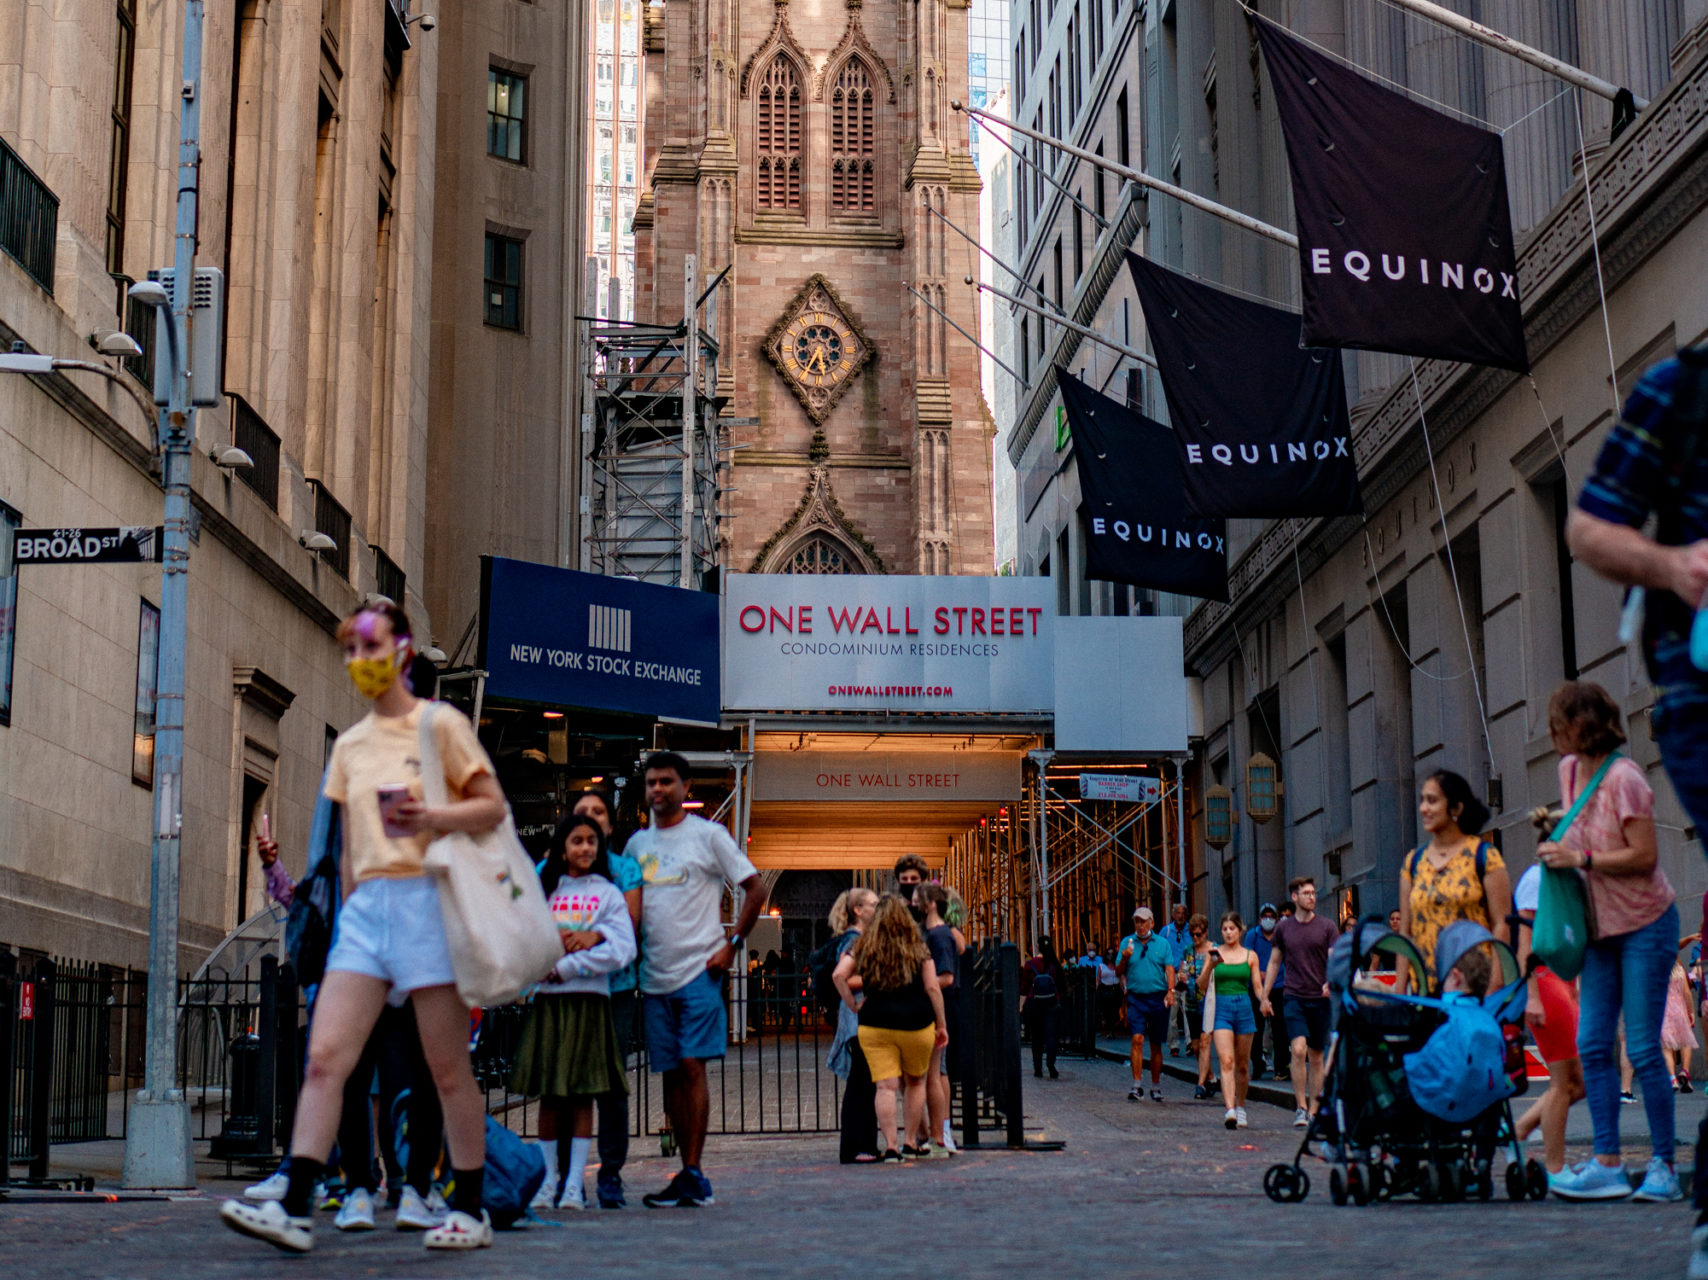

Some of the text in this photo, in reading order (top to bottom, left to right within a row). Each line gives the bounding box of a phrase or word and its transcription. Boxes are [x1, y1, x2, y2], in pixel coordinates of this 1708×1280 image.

[1312, 248, 1517, 300] EQUINOX
[1187, 436, 1349, 466] EQUINOX
[16, 536, 118, 559] BROAD ST
[1093, 517, 1225, 556] EQUINOX
[739, 604, 1043, 635] ONE WALL STREET
[780, 641, 999, 657] CONDOMINIUM RESIDENCES
[510, 643, 702, 686] NEW YORK STOCK EXCHANGE
[828, 685, 953, 697] ONEWALLSTREET.COM
[816, 773, 959, 789] ONE WALL STREET
